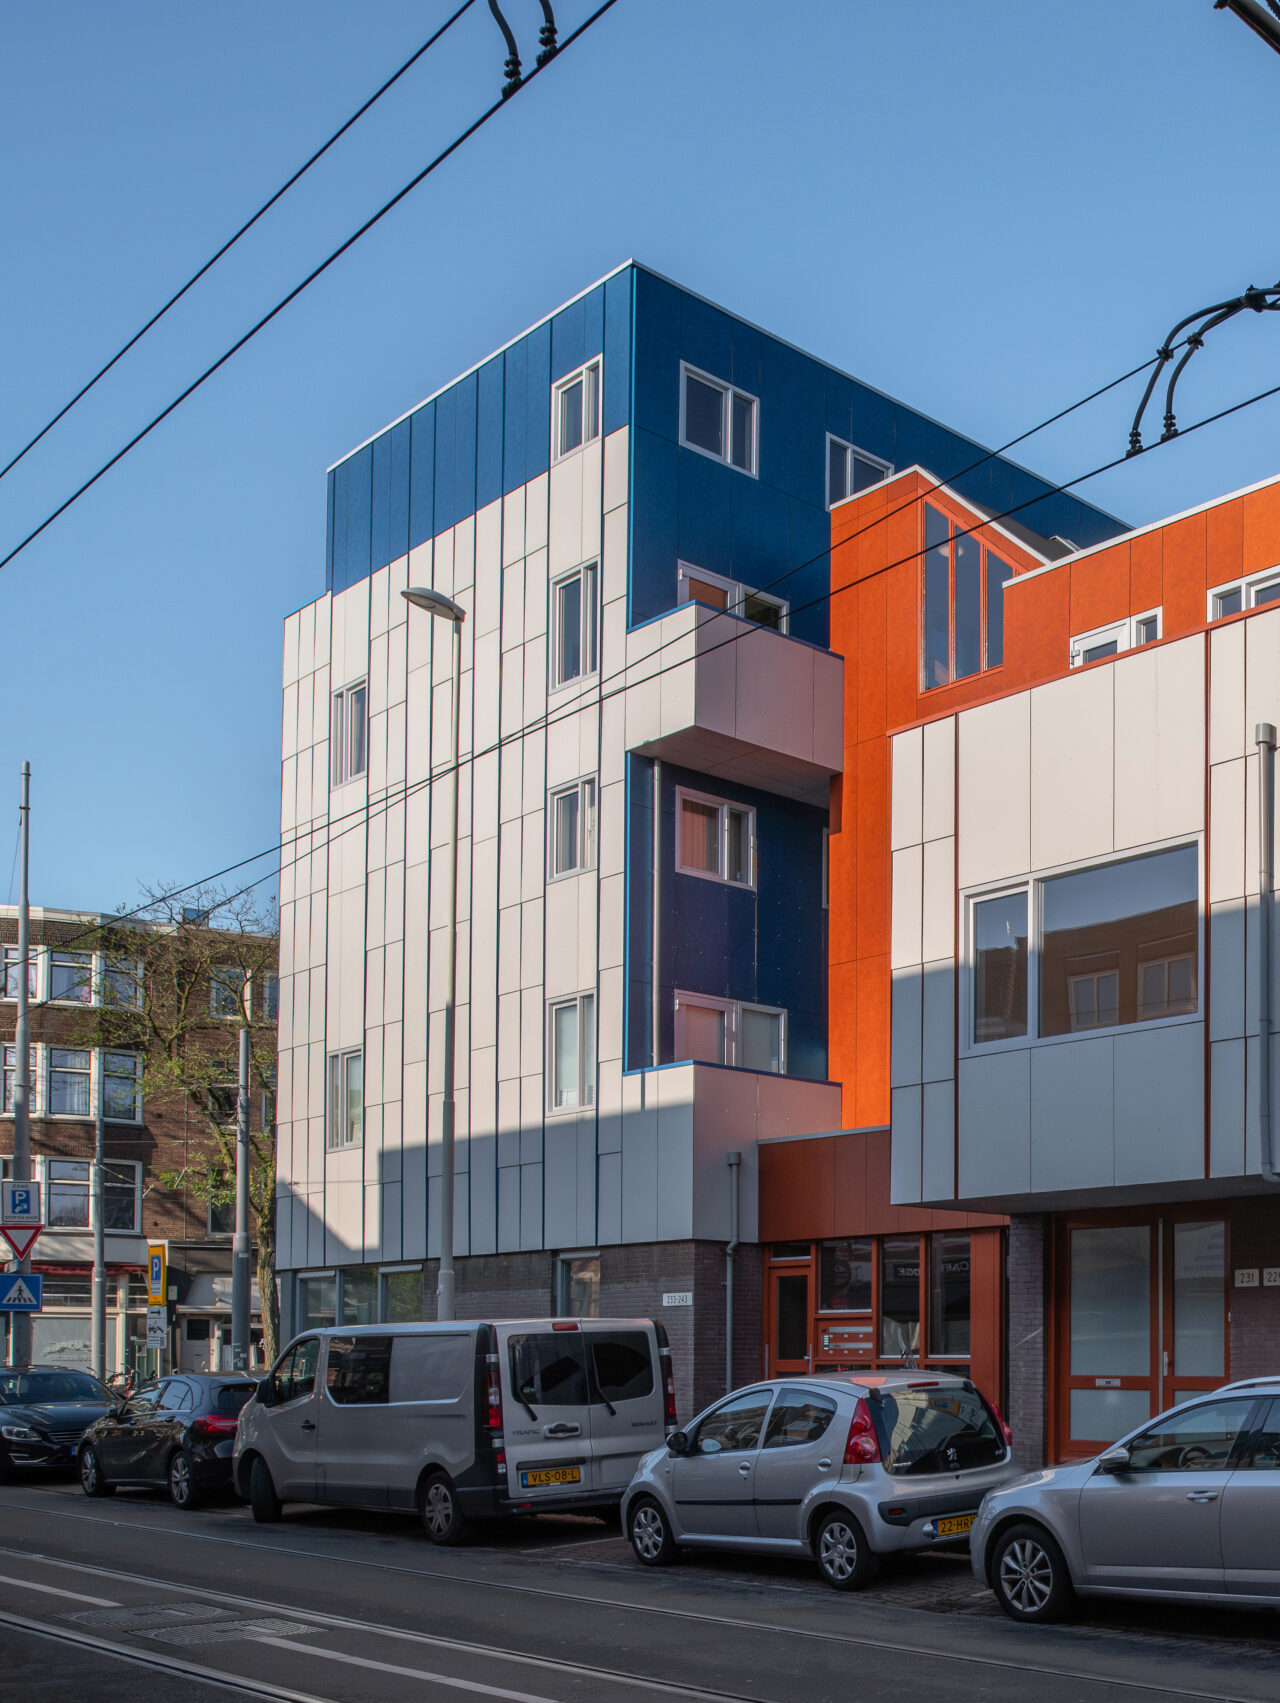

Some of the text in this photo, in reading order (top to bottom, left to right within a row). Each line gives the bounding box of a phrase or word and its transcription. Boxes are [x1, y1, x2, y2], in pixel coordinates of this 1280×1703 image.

[16, 1191, 26, 1204] P
[1240, 1272, 1255, 1284] 231
[666, 1294, 688, 1305] 233-243
[531, 1470, 577, 1482] VLS-08-L
